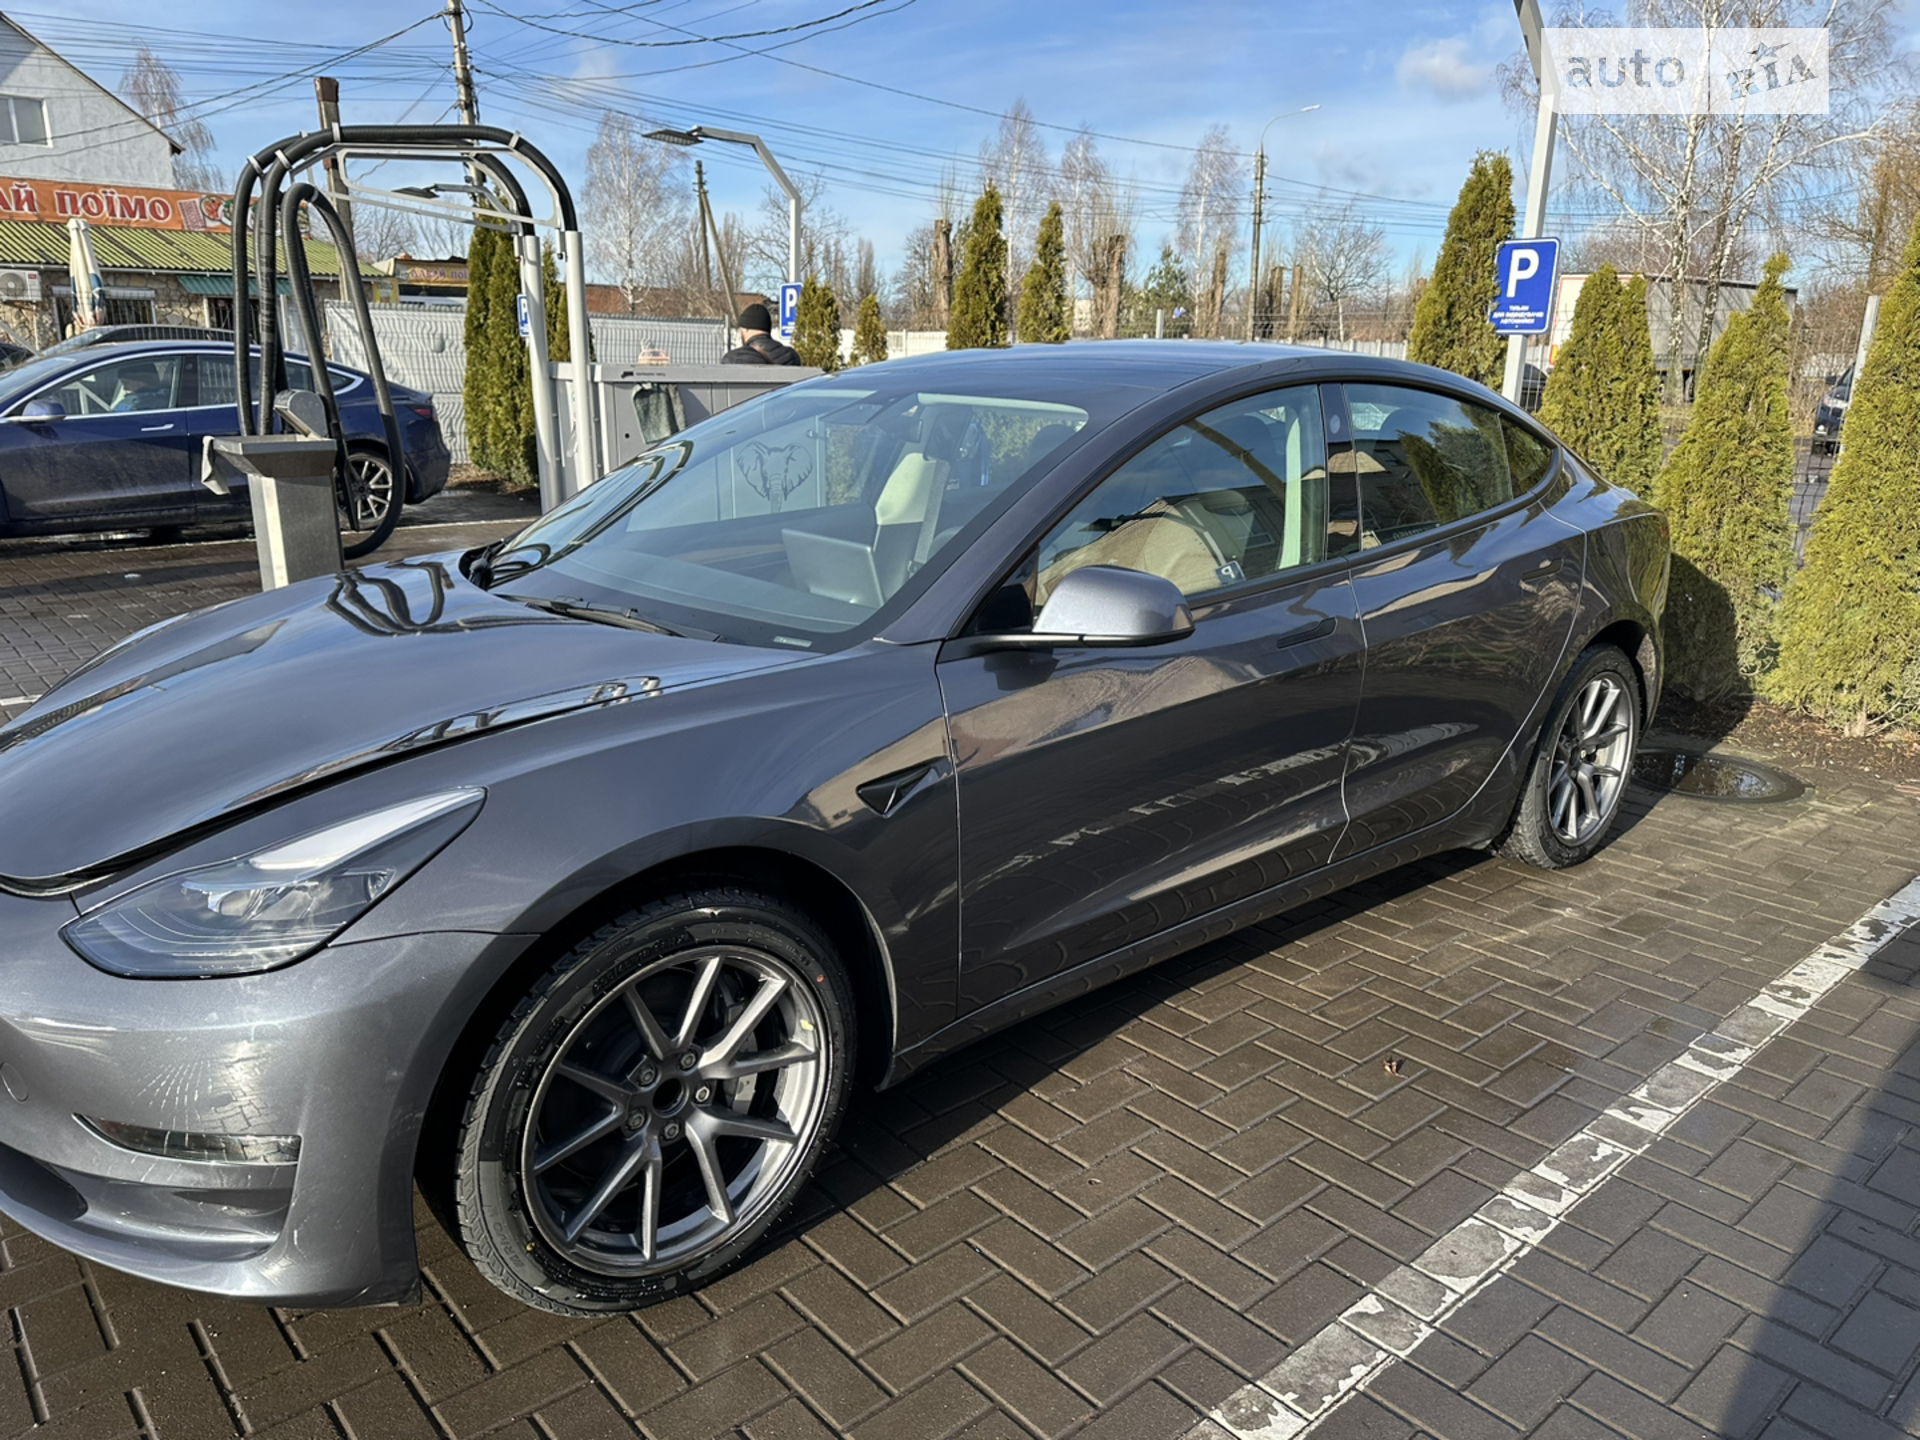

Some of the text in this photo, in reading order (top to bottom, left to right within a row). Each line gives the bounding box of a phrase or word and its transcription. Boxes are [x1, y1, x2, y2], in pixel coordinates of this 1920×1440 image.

[55, 189, 172, 221] ПОЇМО
[1507, 248, 1540, 298] P
[785, 288, 798, 318] P
